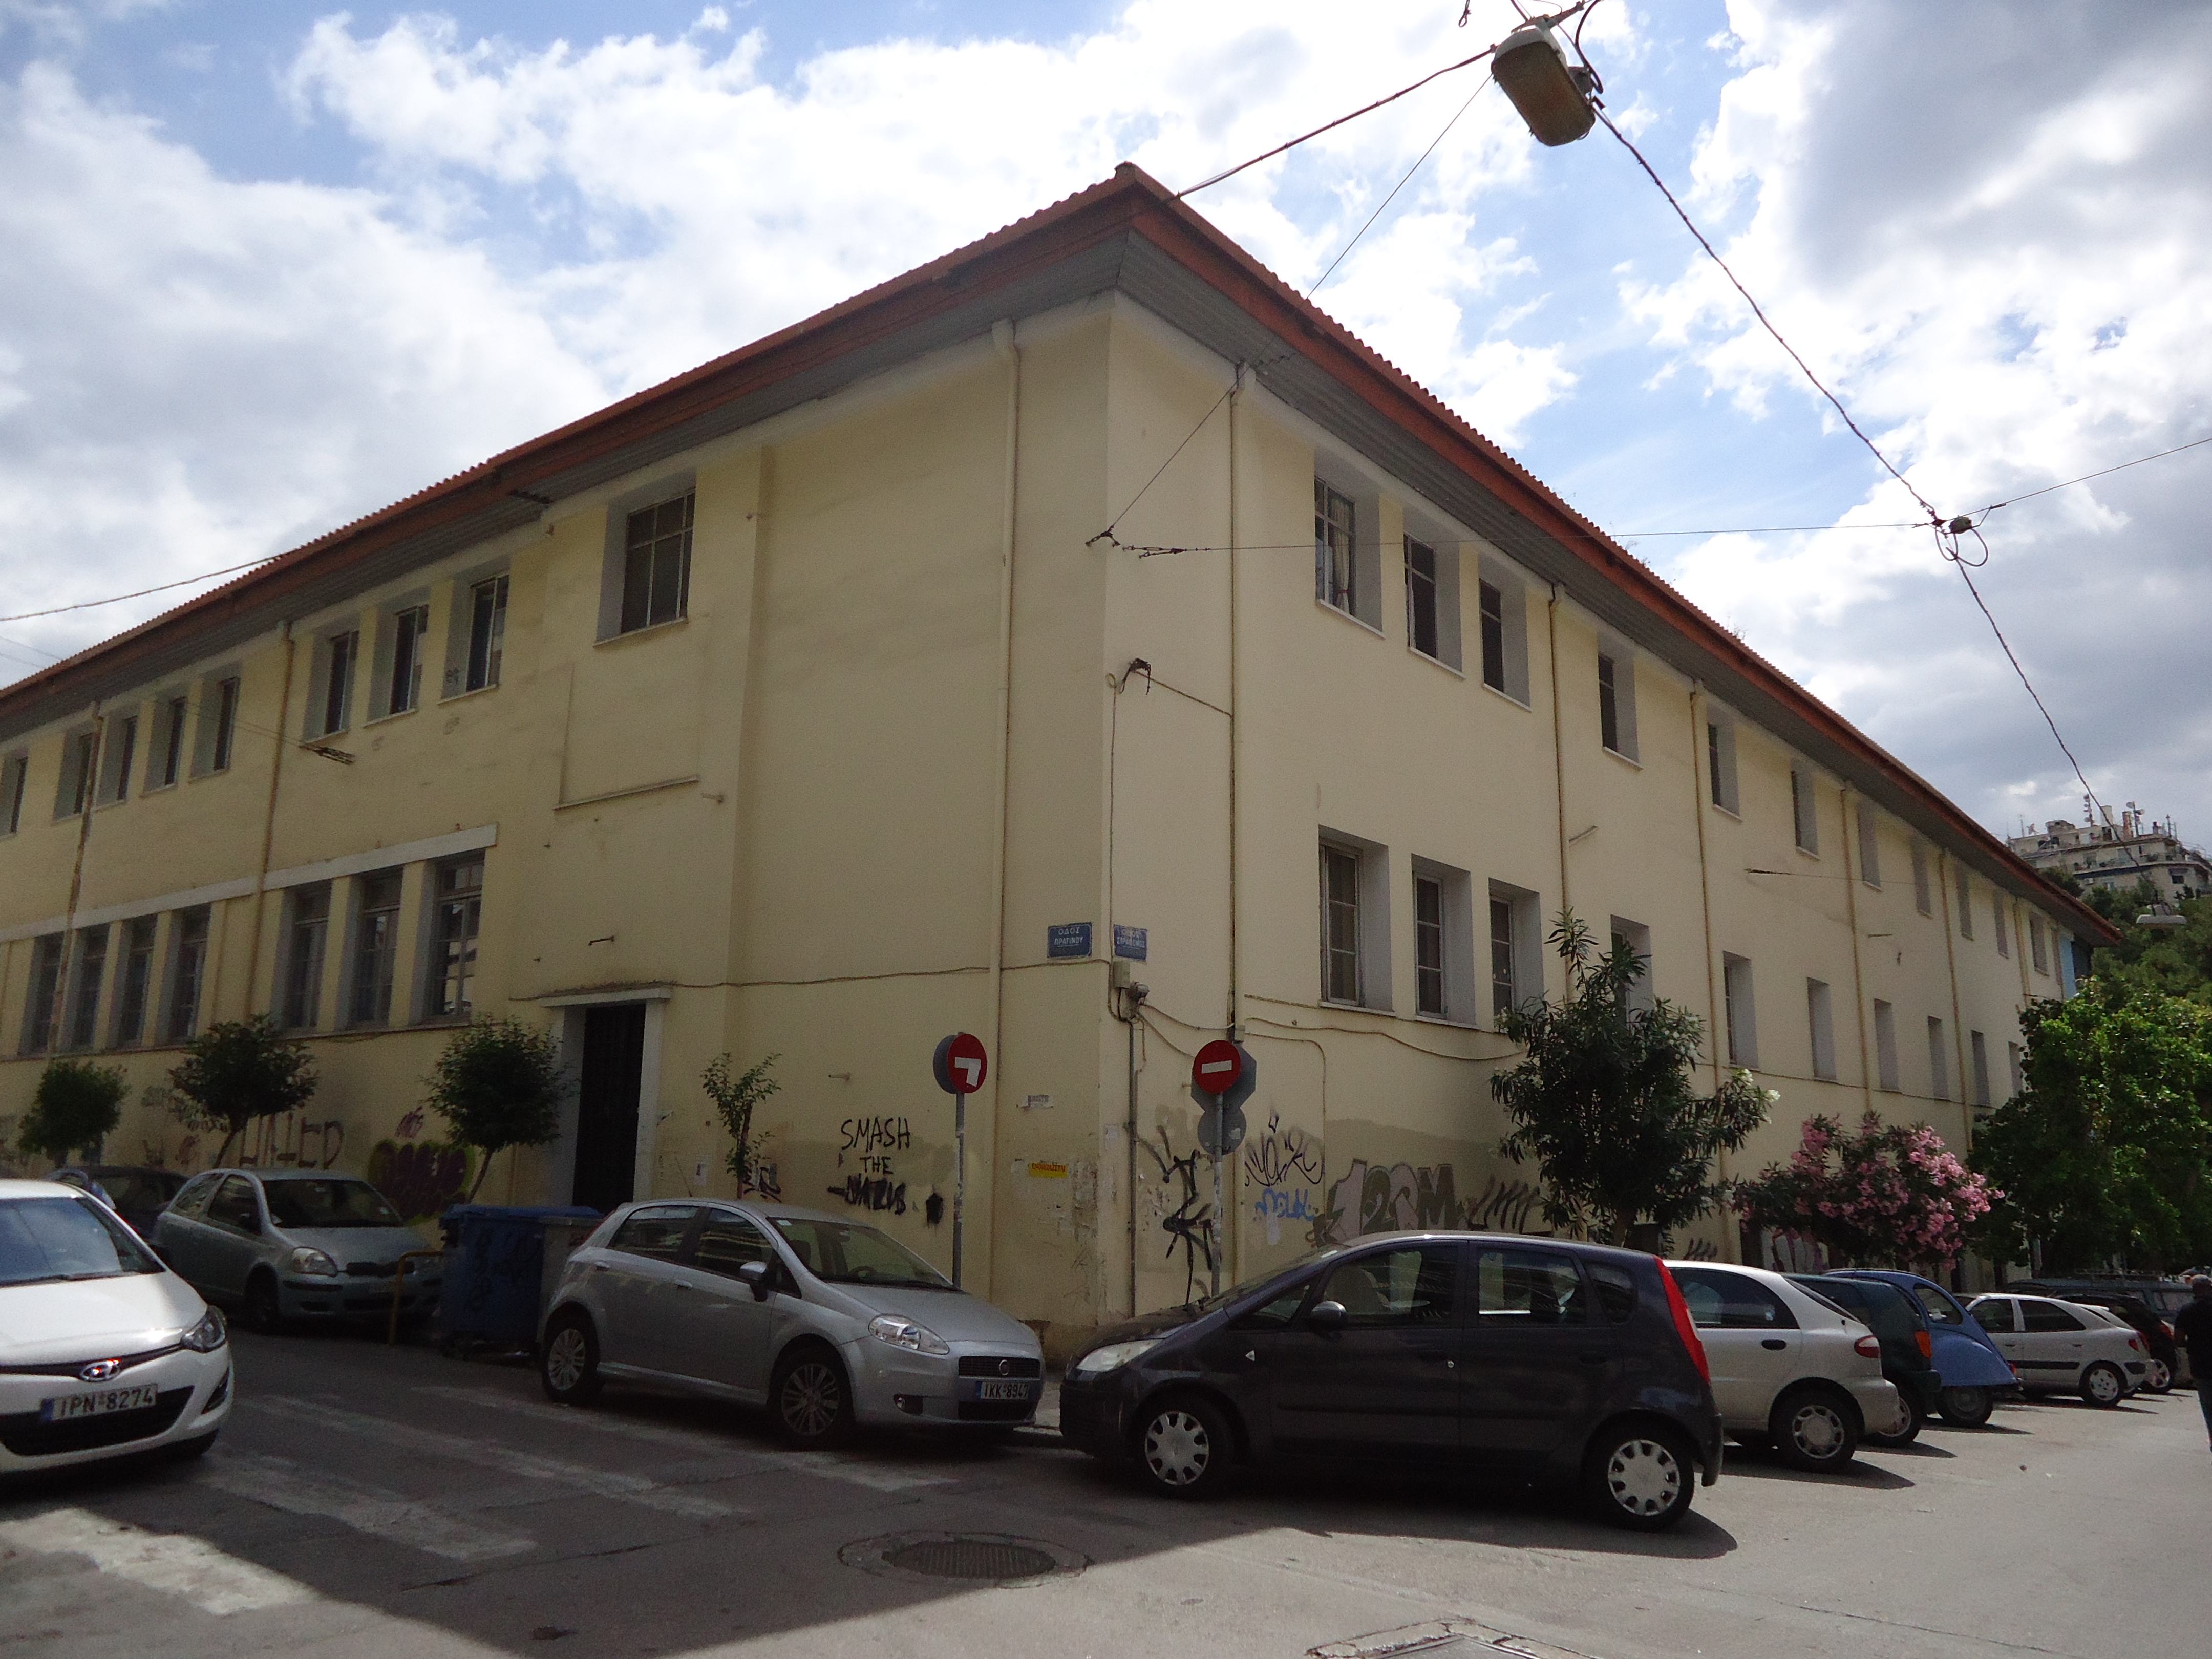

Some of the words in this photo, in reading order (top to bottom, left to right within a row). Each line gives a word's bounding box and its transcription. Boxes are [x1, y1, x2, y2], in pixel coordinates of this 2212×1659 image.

[1058, 927, 1080, 935] ΟΔΟΣ
[1054, 937, 1083, 946] ΠΡΑΤΙΝΟΥ
[841, 1116, 910, 1152] SMASH
[859, 1156, 894, 1174] THE
